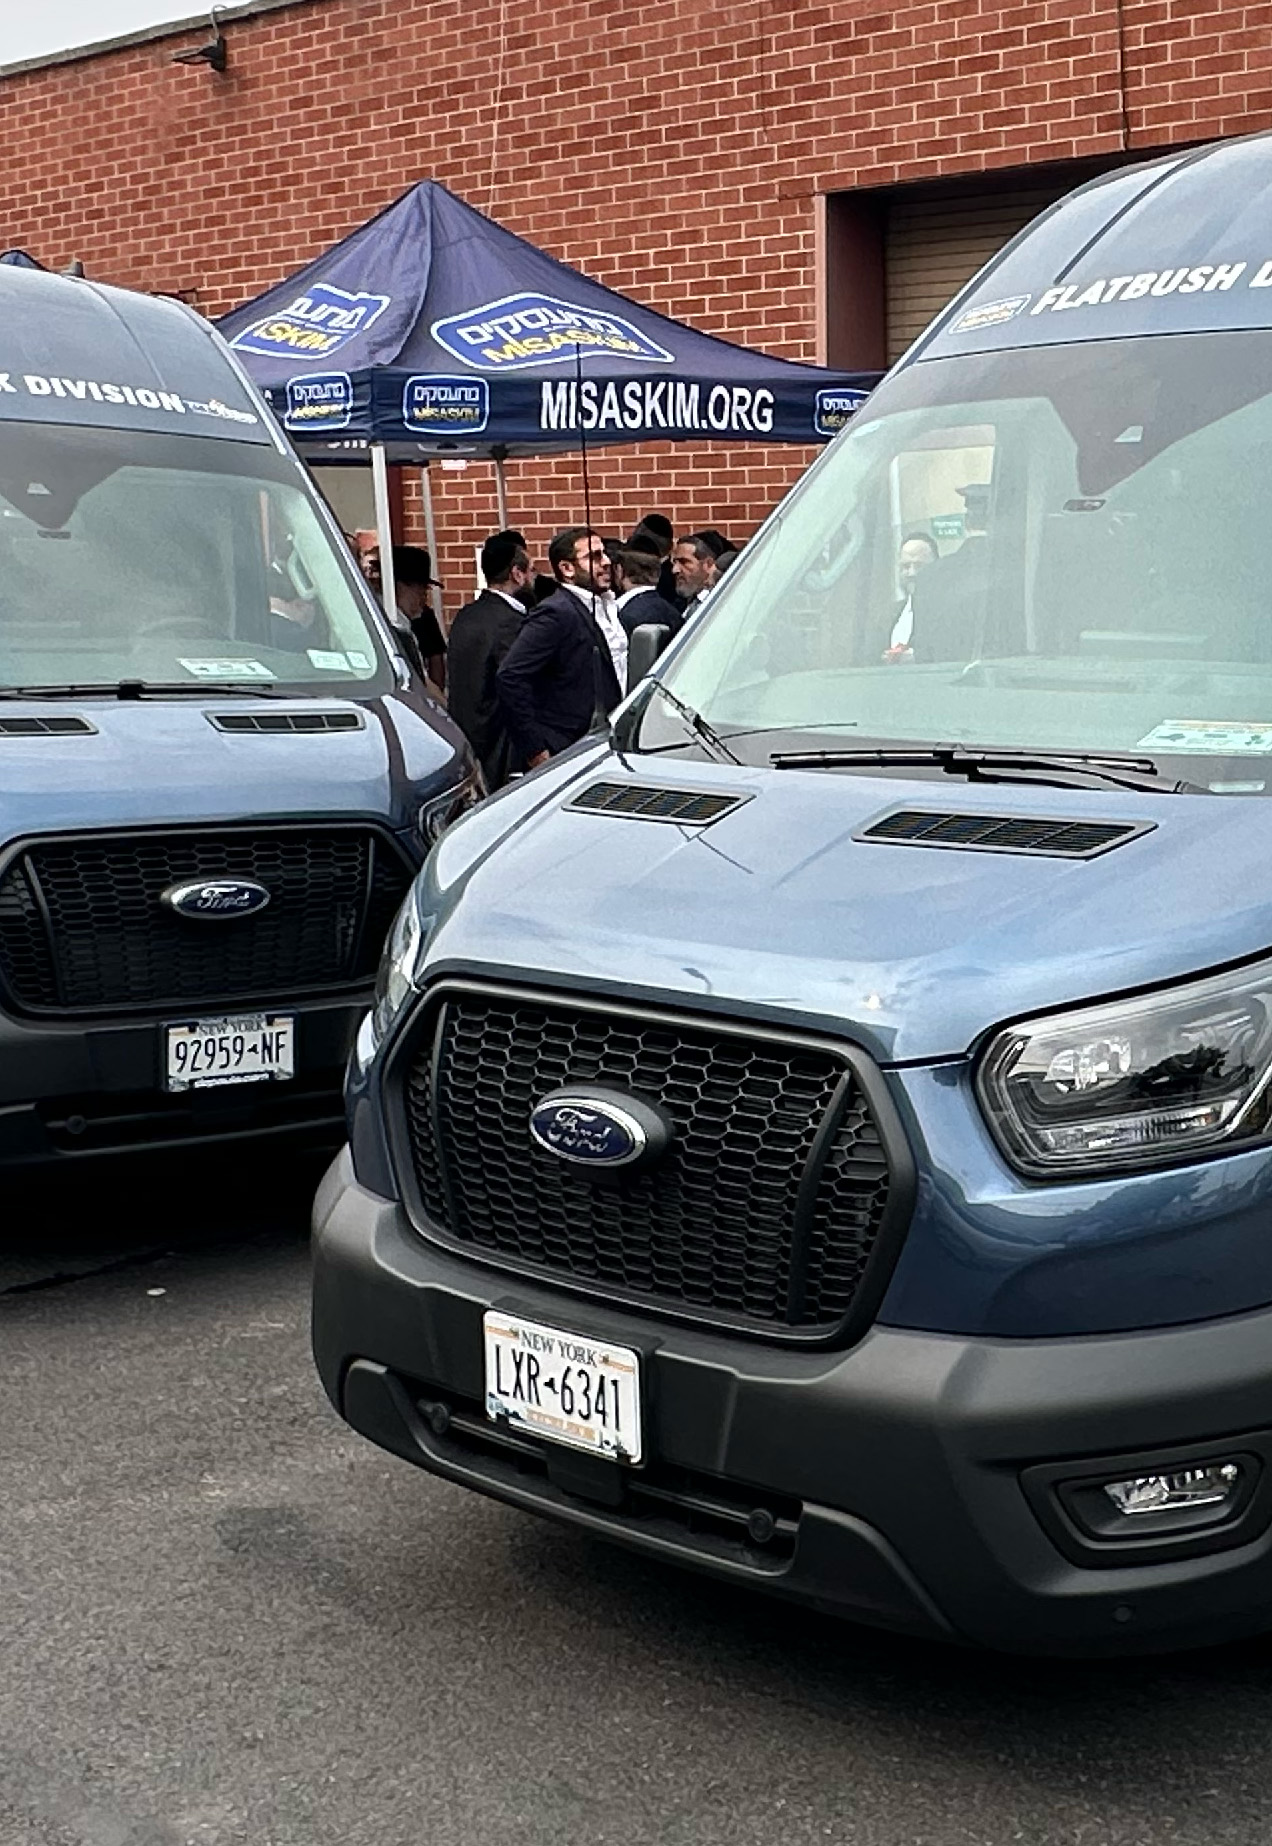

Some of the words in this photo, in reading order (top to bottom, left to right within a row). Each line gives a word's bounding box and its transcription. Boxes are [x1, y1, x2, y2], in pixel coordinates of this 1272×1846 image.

[1030, 262, 1247, 315] FLATBUSH
[23, 375, 186, 413] DIVISION
[540, 381, 775, 432] MISASKIM.ORG
[197, 885, 250, 909] Ford
[230, 1017, 265, 1034] YORK
[521, 1330, 556, 1351] NEW
[554, 1339, 598, 1369] YORK
